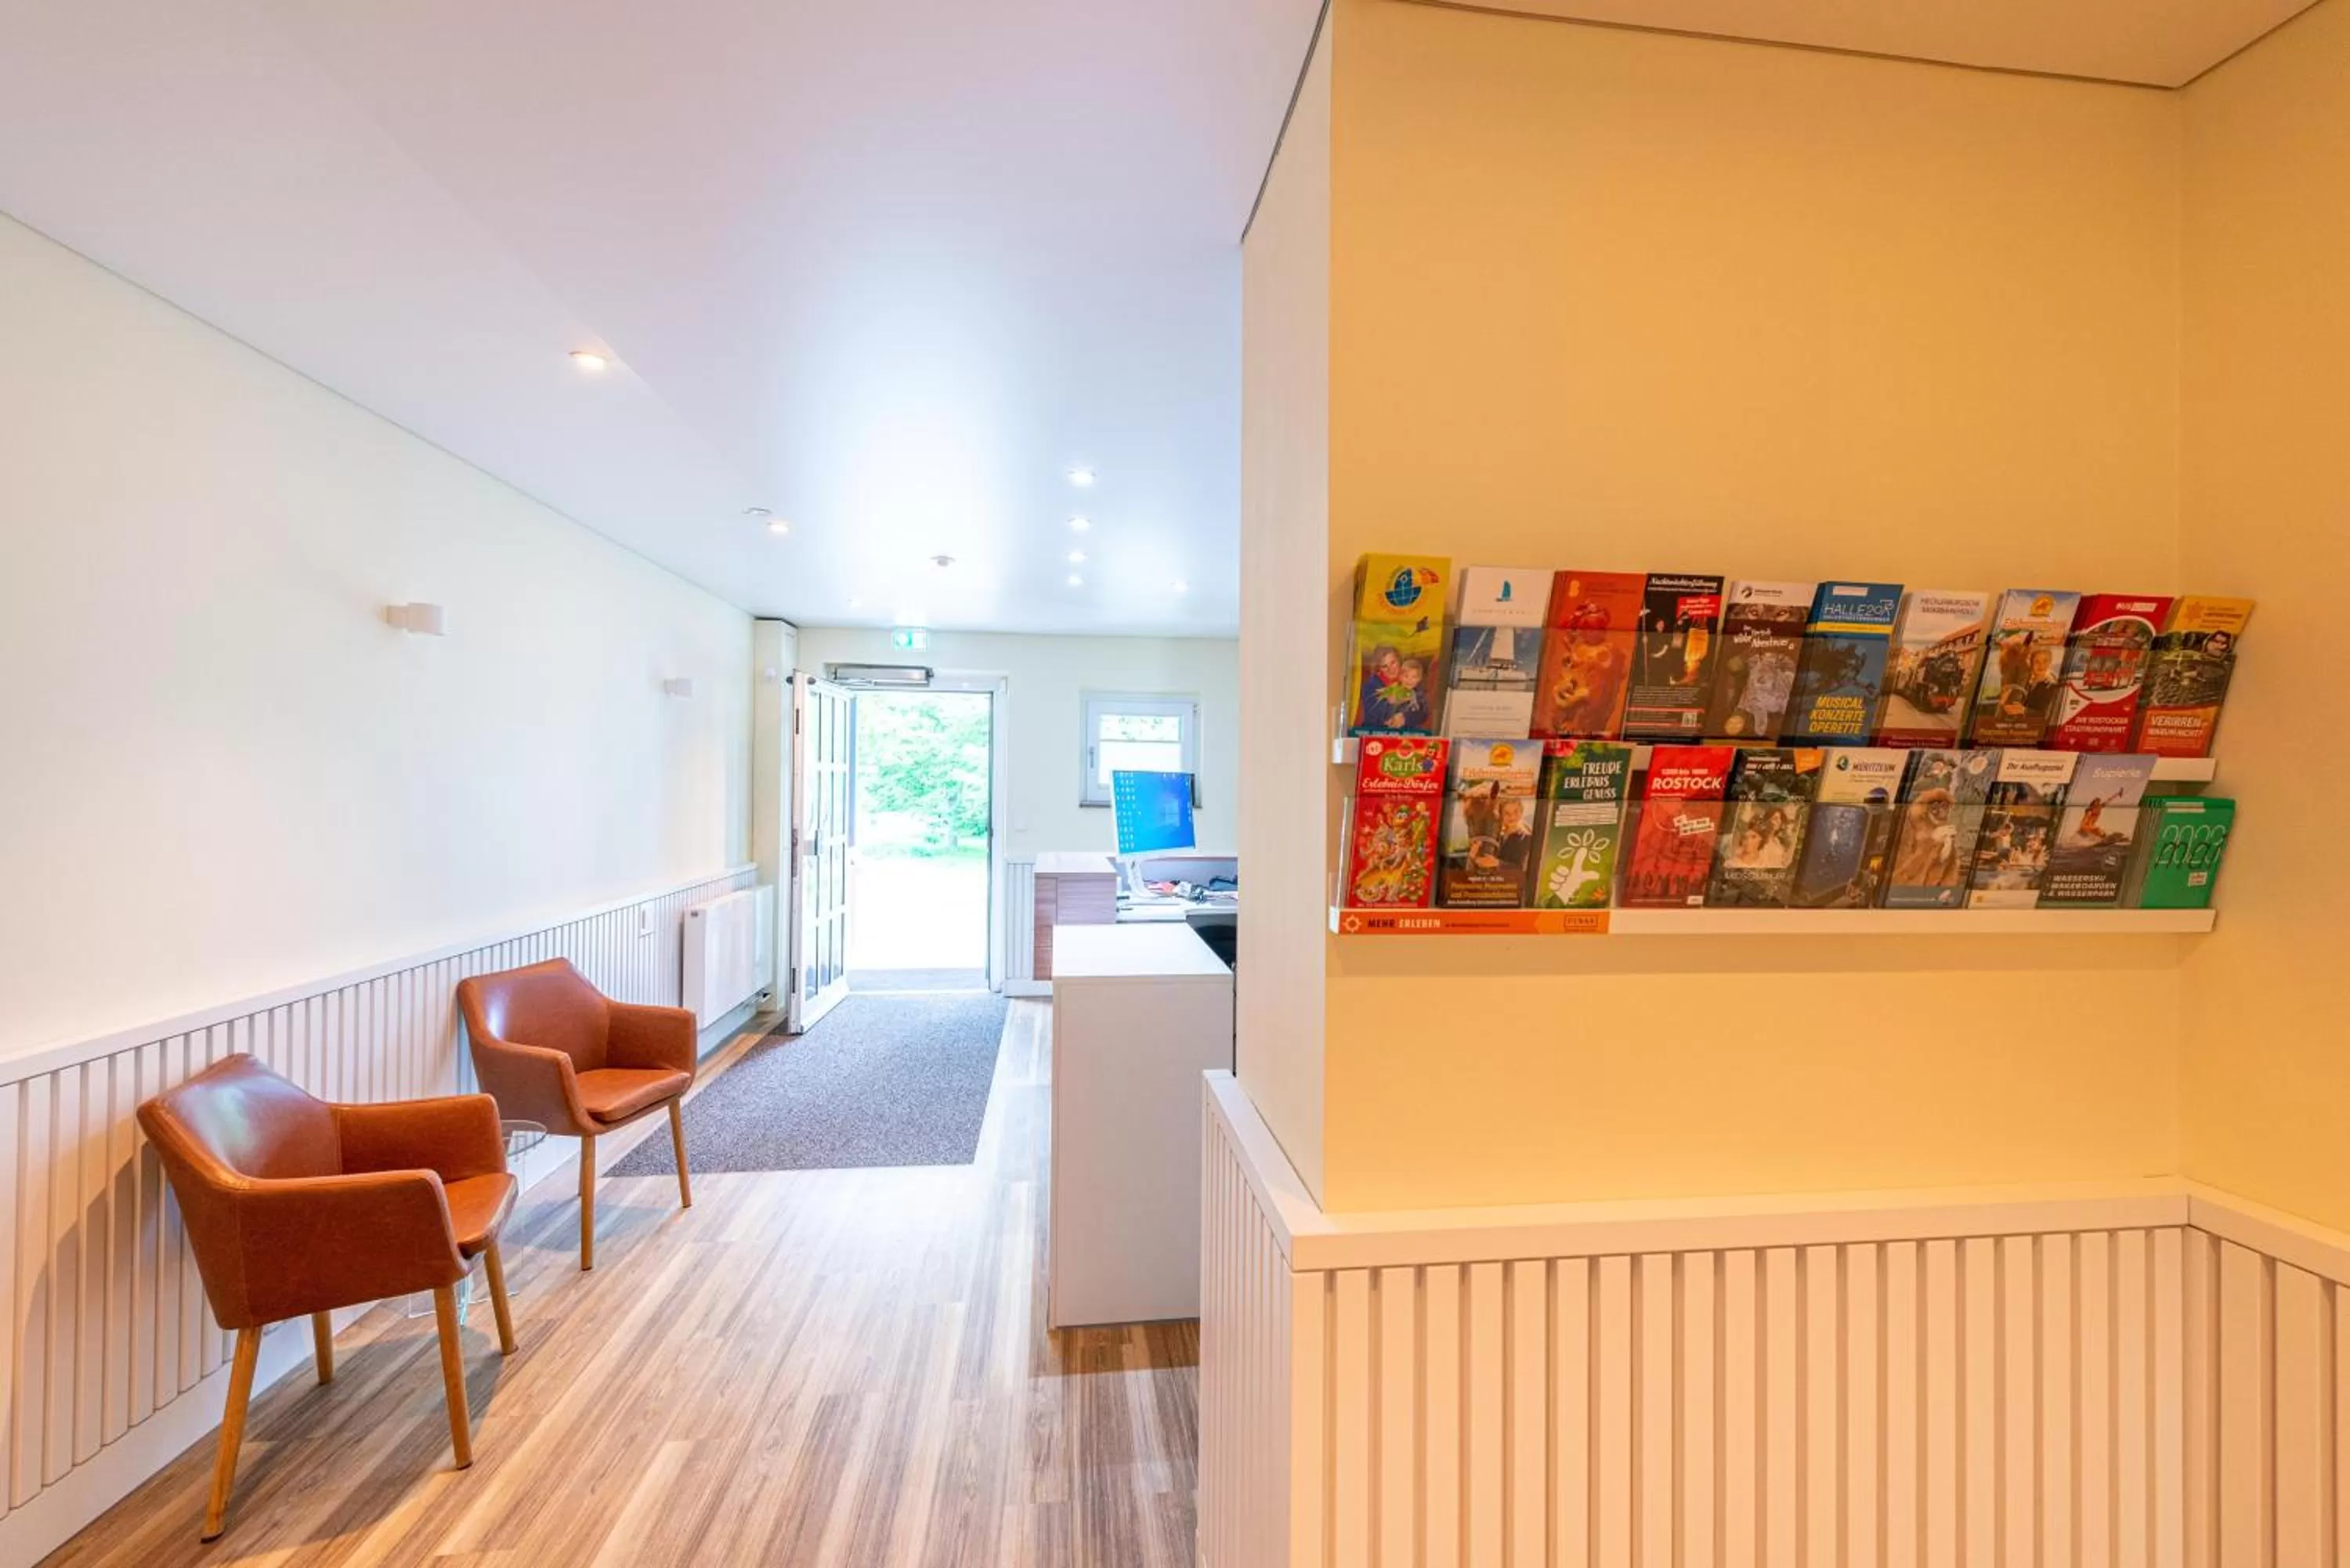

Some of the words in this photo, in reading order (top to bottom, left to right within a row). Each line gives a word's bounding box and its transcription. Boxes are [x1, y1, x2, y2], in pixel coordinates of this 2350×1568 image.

[1816, 695, 1864, 710] MUSICAL
[1810, 709, 1866, 721] KONZERTE
[1809, 721, 1864, 734] OPERETTE
[1383, 757, 1423, 771] Karls
[1582, 761, 1622, 775] FREUDE
[1564, 775, 1610, 789] ERLEBNIS
[1651, 776, 1723, 789] ROSTOCK
[1582, 788, 1617, 800] GENUSS
[1367, 919, 1396, 928] MEHR
[1399, 919, 1441, 929] ERLEBEN
